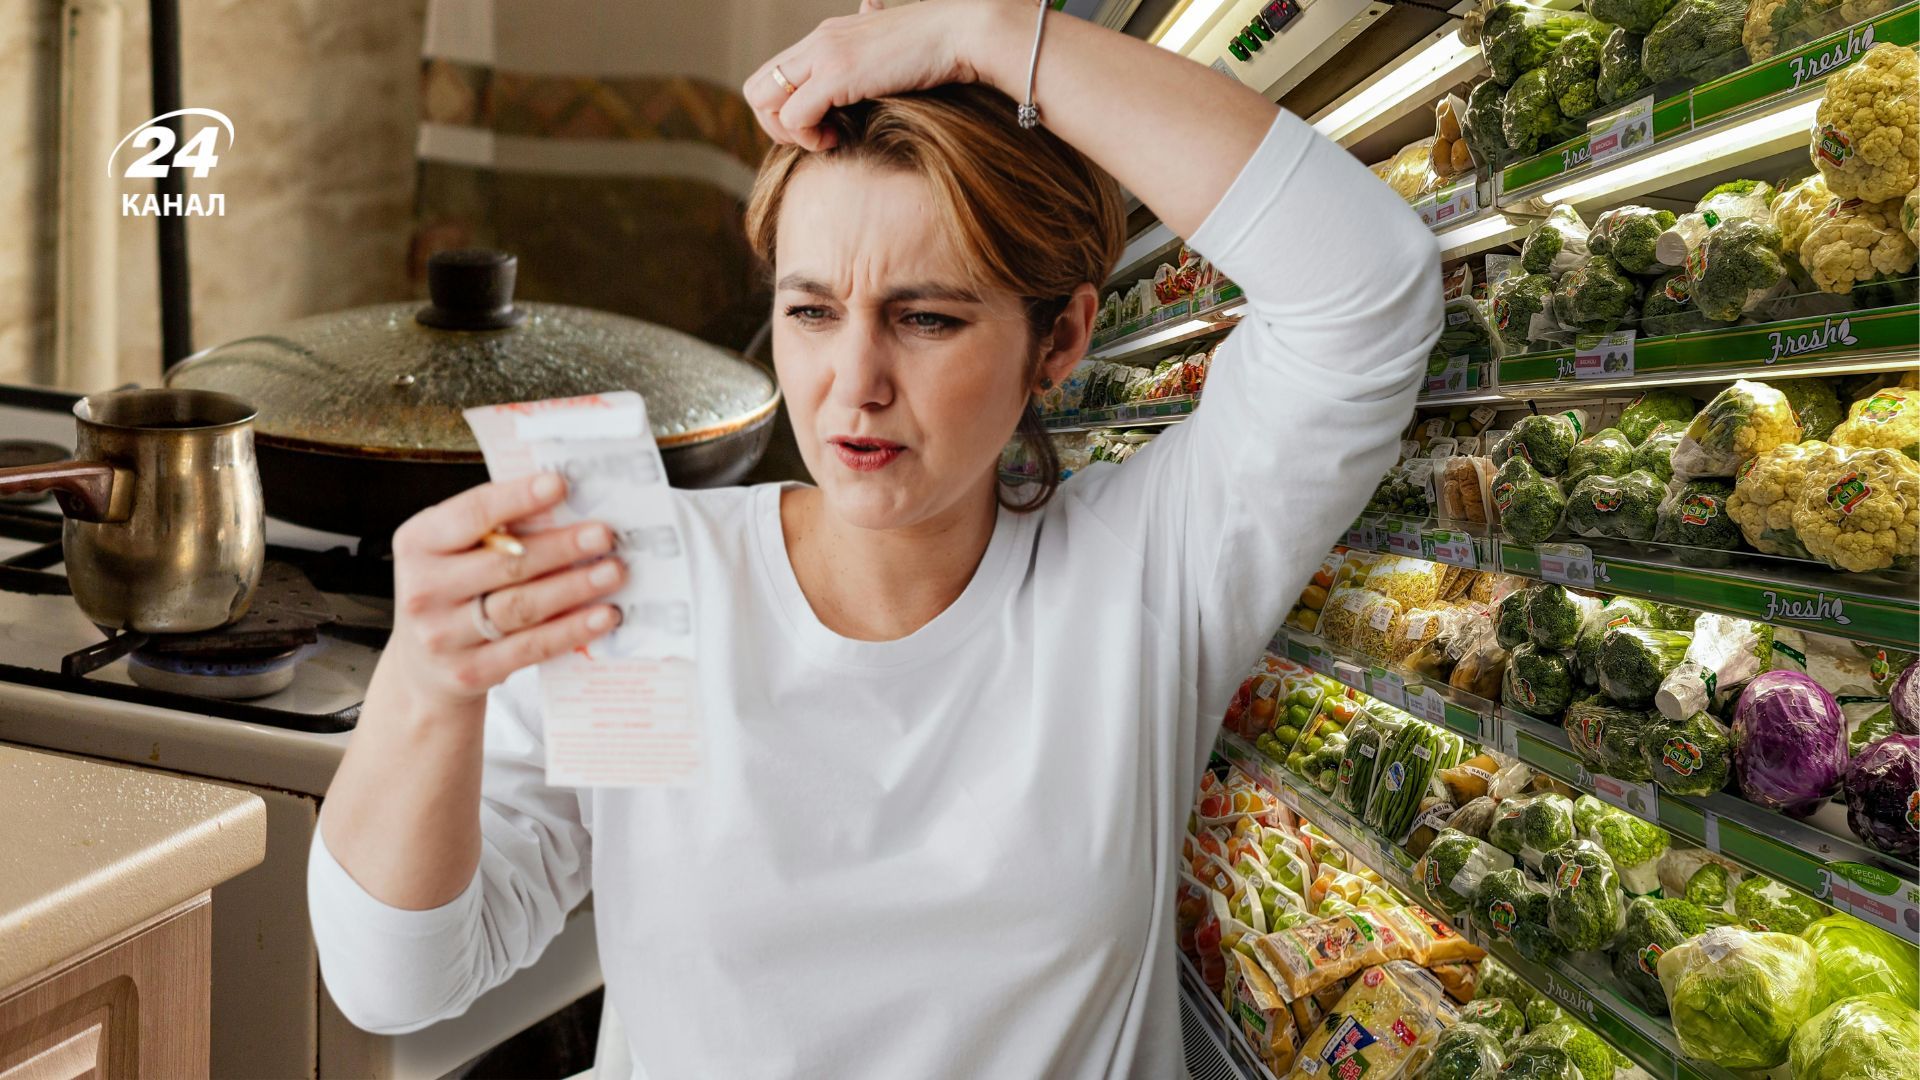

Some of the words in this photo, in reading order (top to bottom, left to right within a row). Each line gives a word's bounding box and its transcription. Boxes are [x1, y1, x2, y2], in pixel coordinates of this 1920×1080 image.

[1786, 29, 1861, 93] Fresh
[1561, 142, 1592, 172] Fres
[1765, 318, 1837, 365] Fresh
[1762, 591, 1831, 620] Fresh
[1543, 972, 1587, 1012] Fresh
